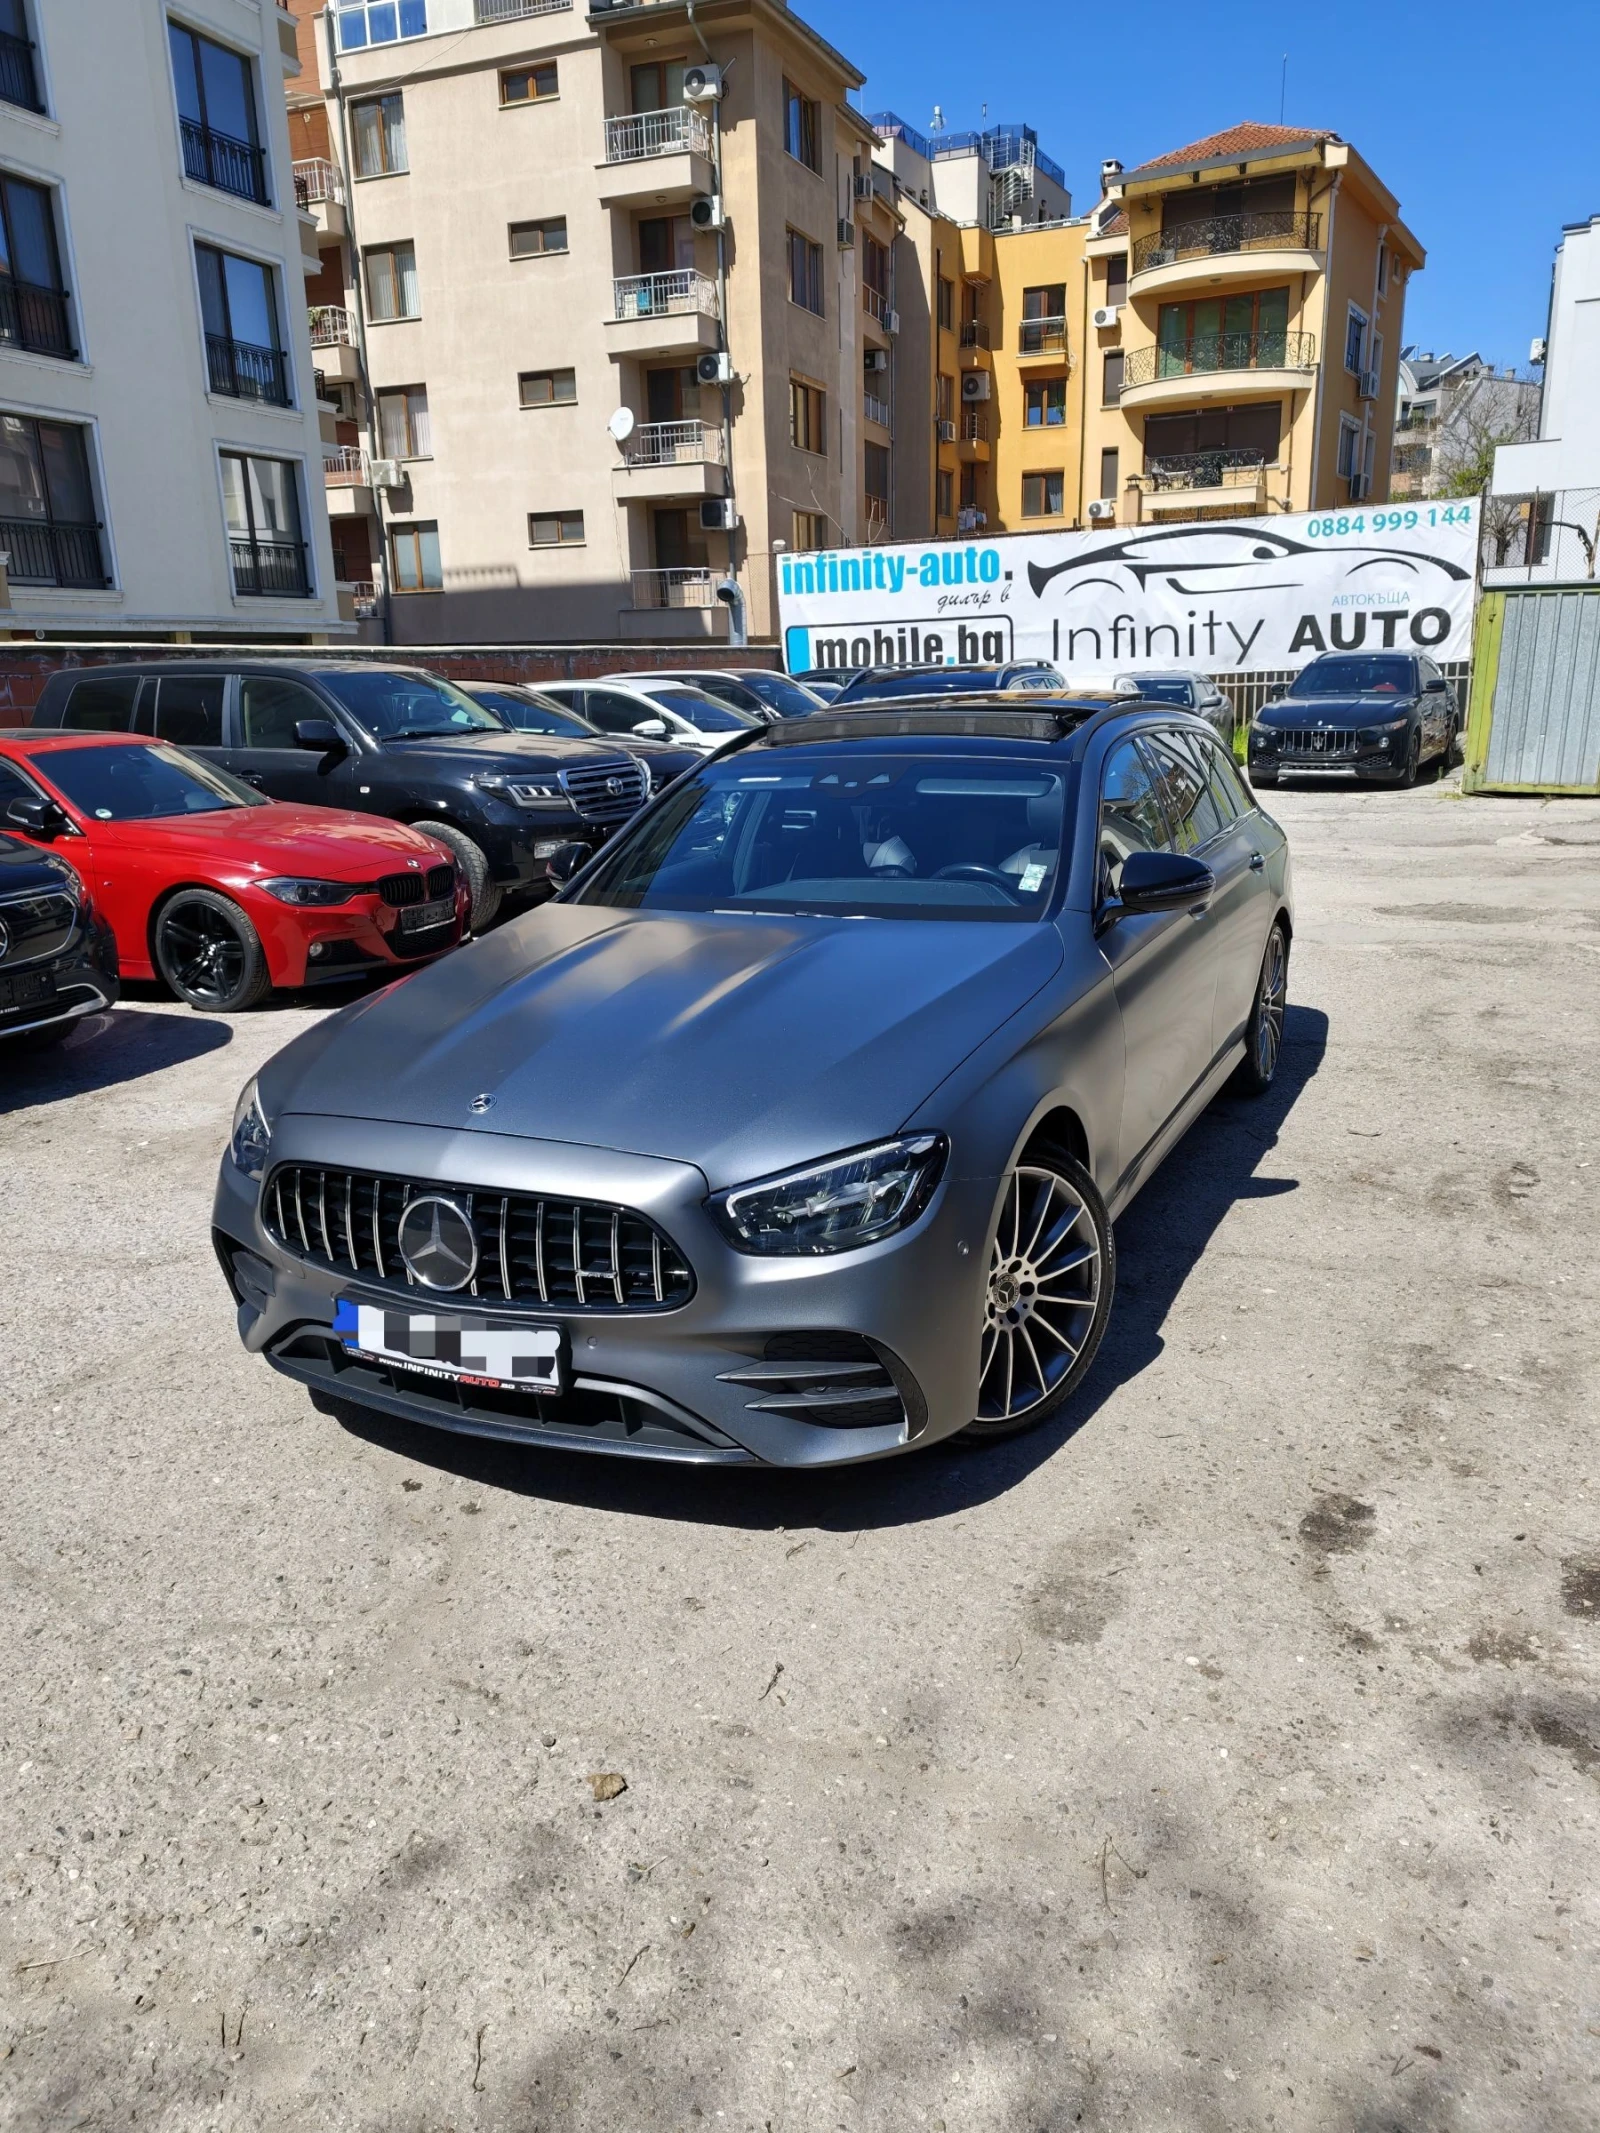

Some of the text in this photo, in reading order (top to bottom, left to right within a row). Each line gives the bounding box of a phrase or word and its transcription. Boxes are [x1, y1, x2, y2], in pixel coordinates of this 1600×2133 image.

[1307, 505, 1472, 538] 0884 999 144
[937, 589, 992, 613] дилър
[1331, 591, 1411, 606] АВТОКЪЩА
[1053, 607, 1452, 666] Infinity AUTO
